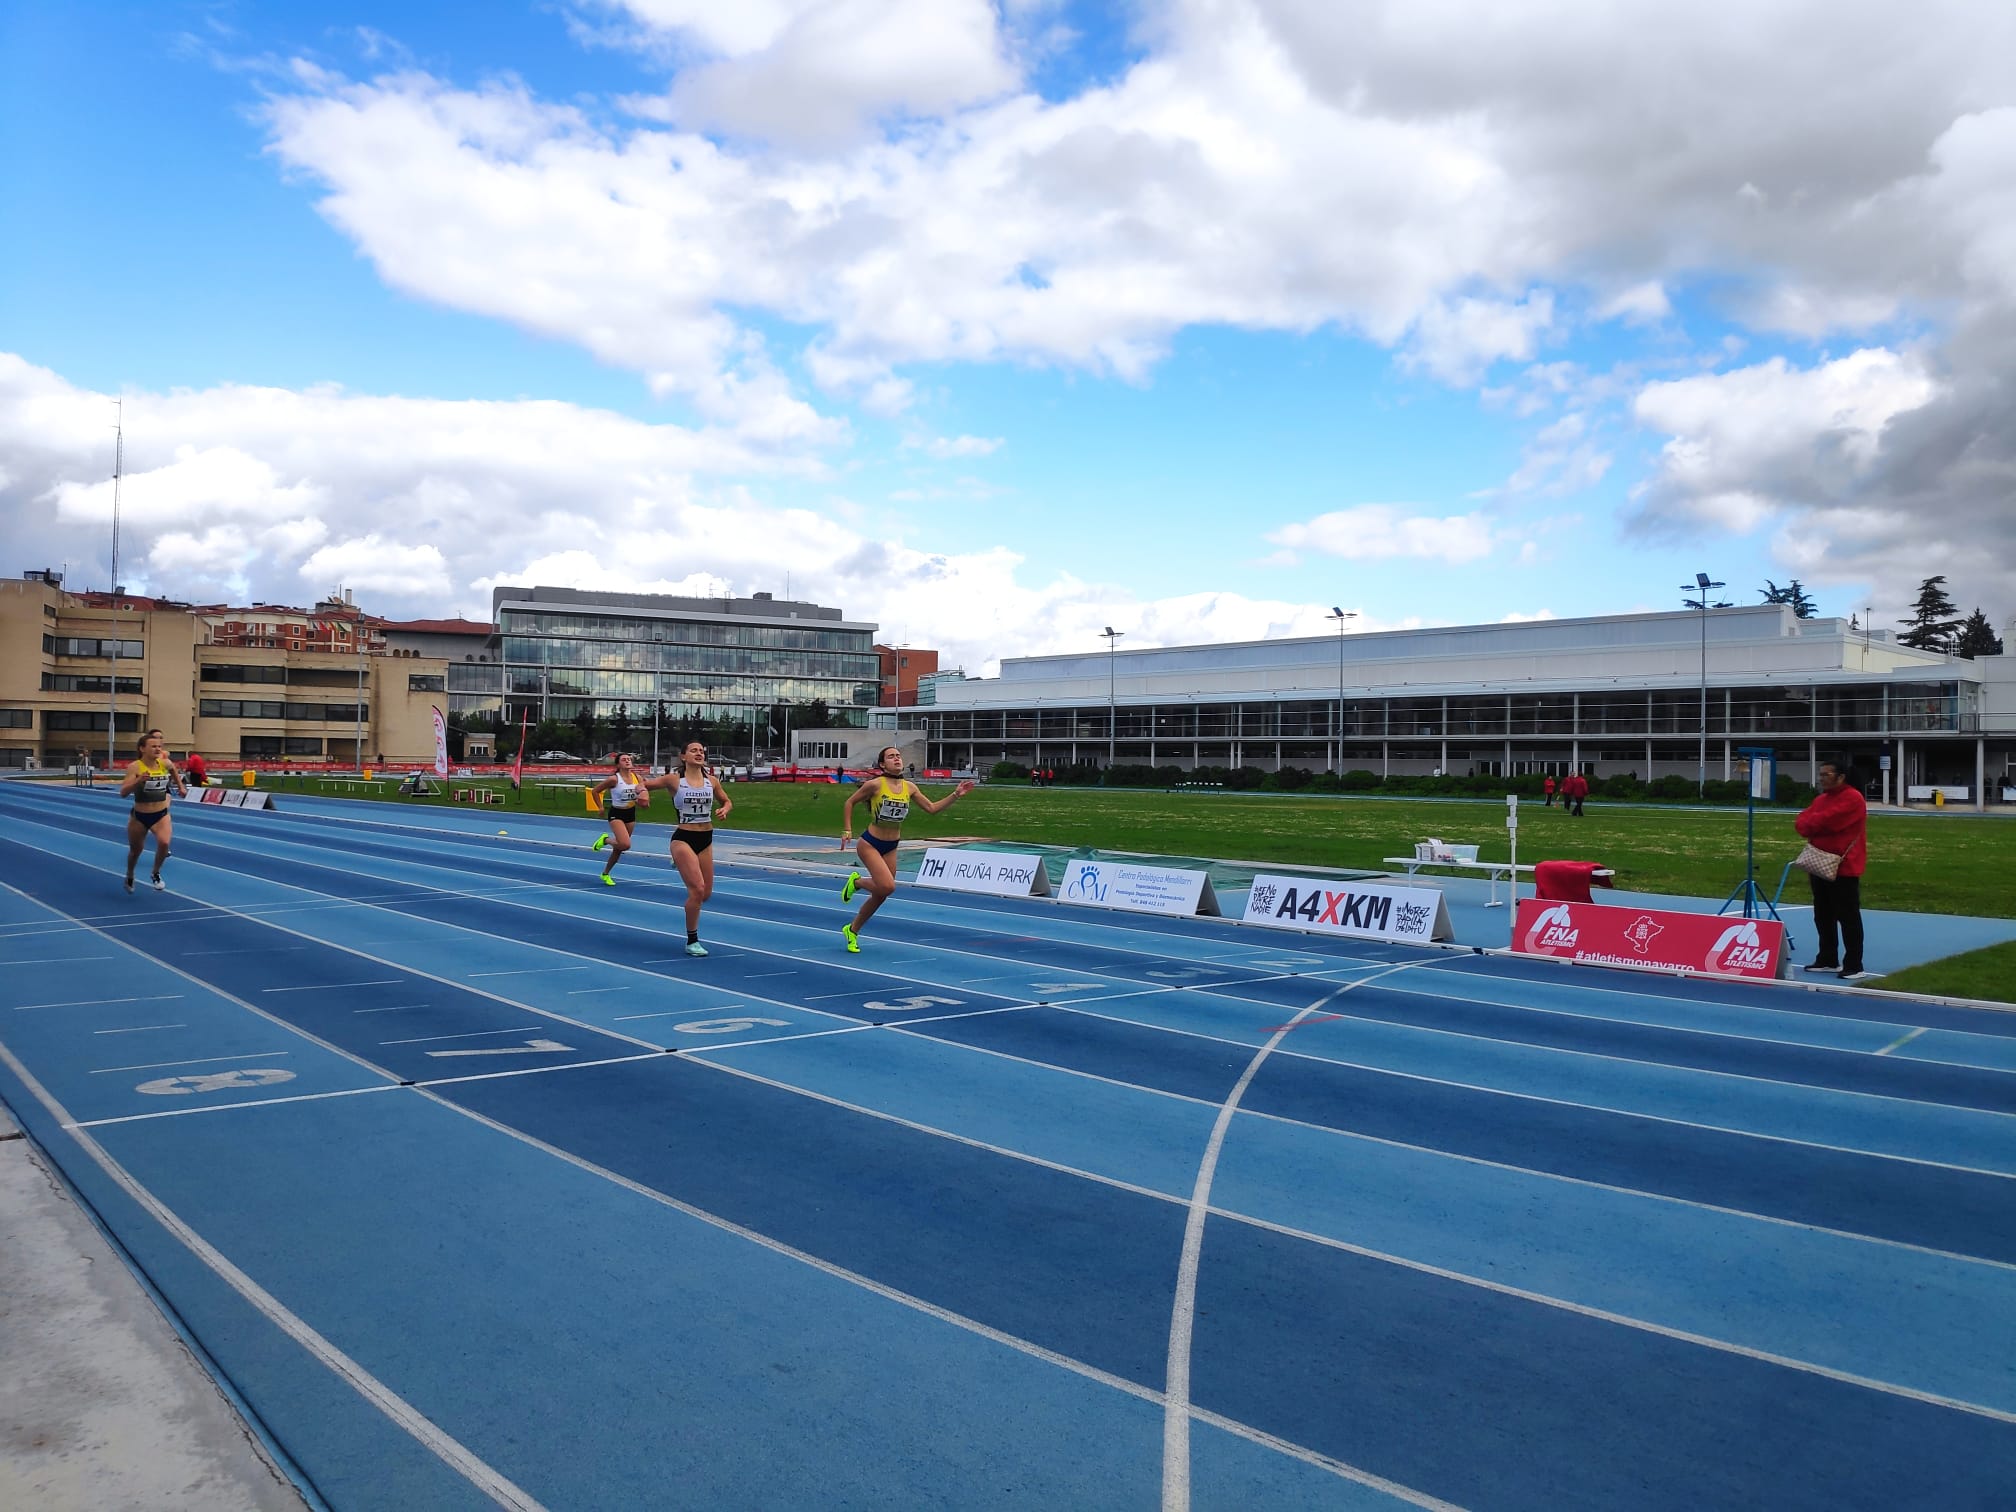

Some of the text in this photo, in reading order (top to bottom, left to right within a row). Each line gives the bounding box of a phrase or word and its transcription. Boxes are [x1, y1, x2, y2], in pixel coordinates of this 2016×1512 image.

[691, 804, 704, 813] 11
[890, 808, 902, 817] 12
[953, 862, 1034, 885] IRUÑA PARK
[1276, 887, 1392, 930] A4XKM
[1539, 938, 1576, 948] ATLETISMO
[1544, 926, 1580, 943] FNA
[1727, 946, 1771, 964] FNA
[1723, 958, 1767, 970] ATLETISMO
[863, 995, 969, 1011] 5
[673, 1017, 794, 1034] 6
[135, 1068, 297, 1095] 8
